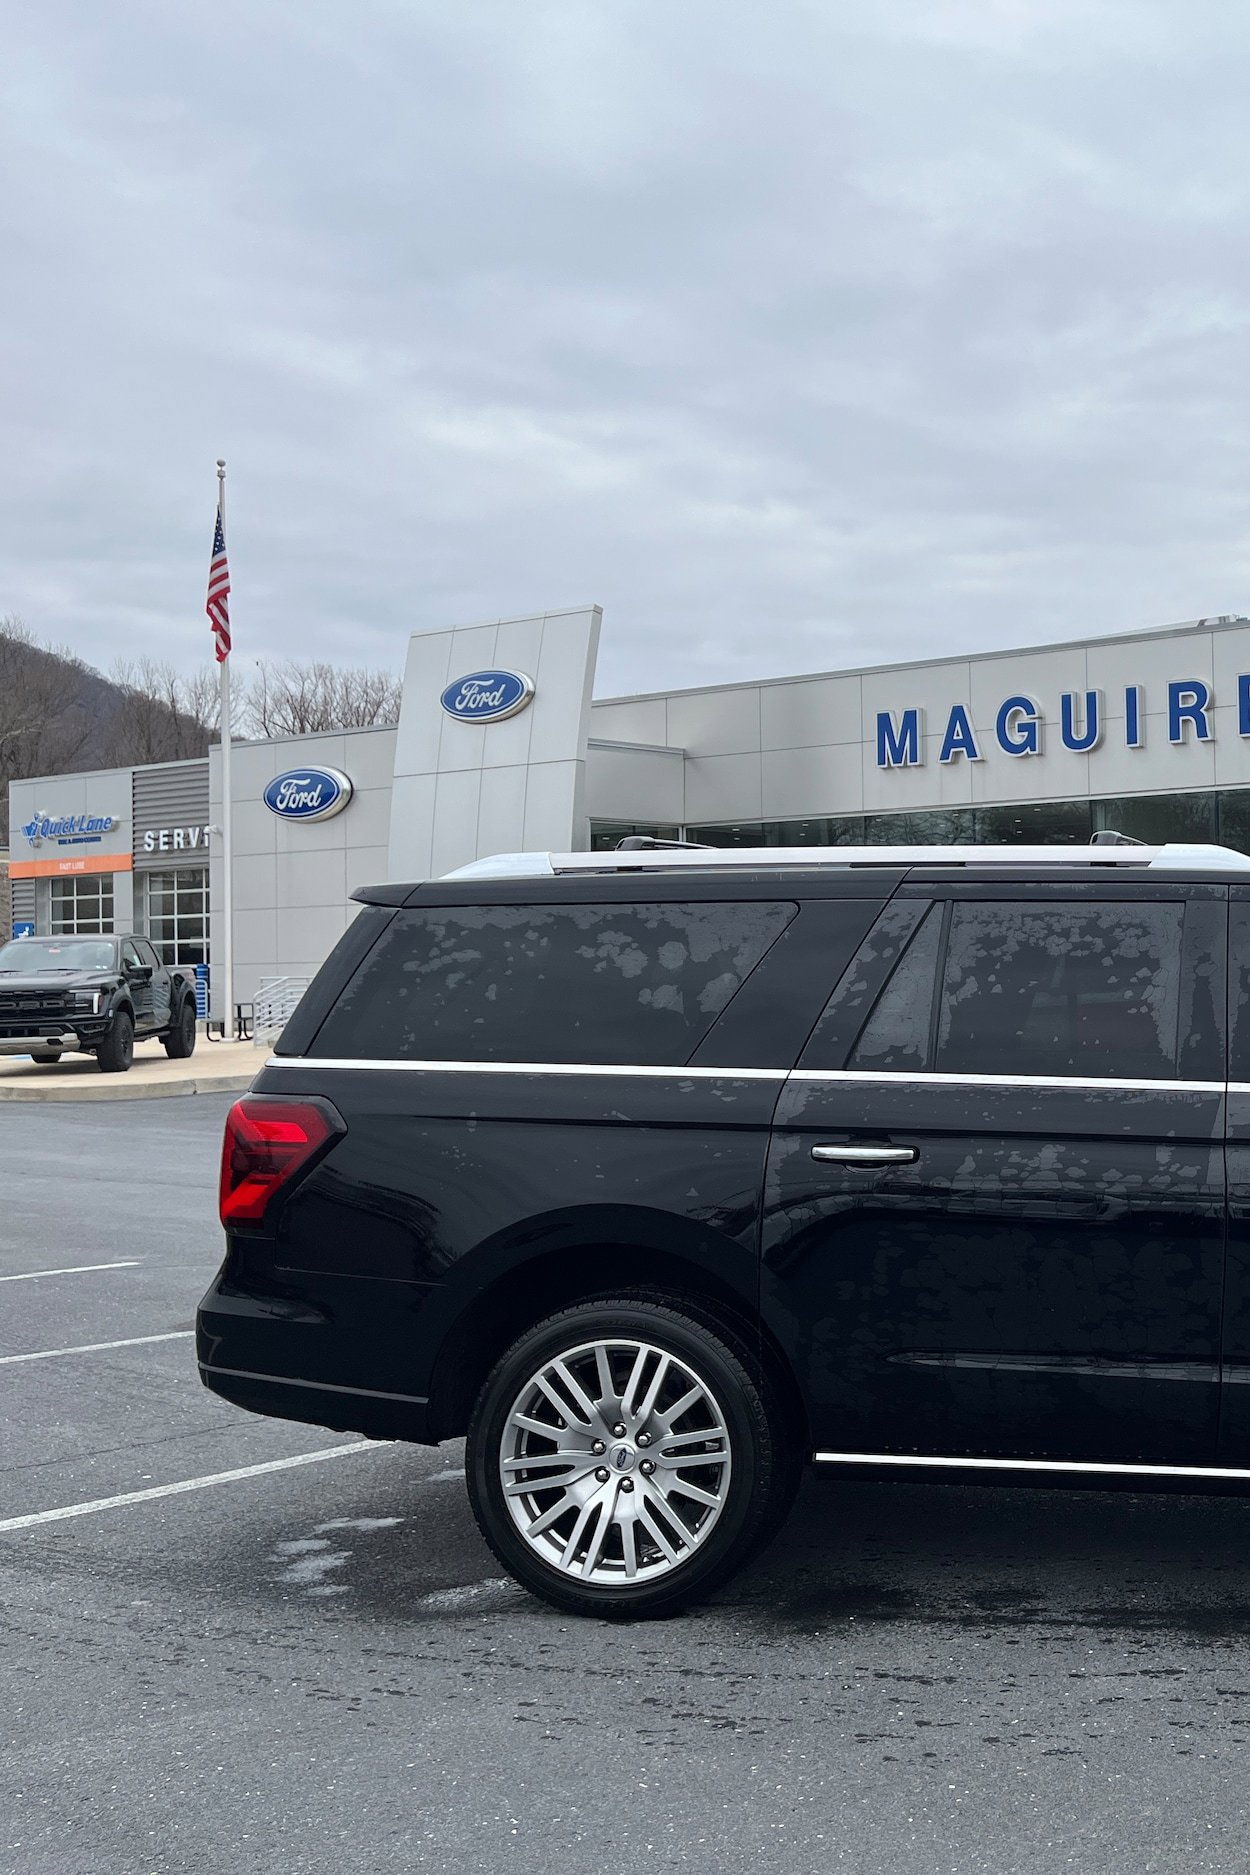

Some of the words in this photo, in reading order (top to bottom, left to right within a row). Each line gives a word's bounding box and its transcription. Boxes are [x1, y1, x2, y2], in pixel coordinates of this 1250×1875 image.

[455, 679, 504, 711] Ford
[276, 778, 321, 810] Ford
[40, 816, 75, 838] Quick
[78, 815, 112, 833] Lane
